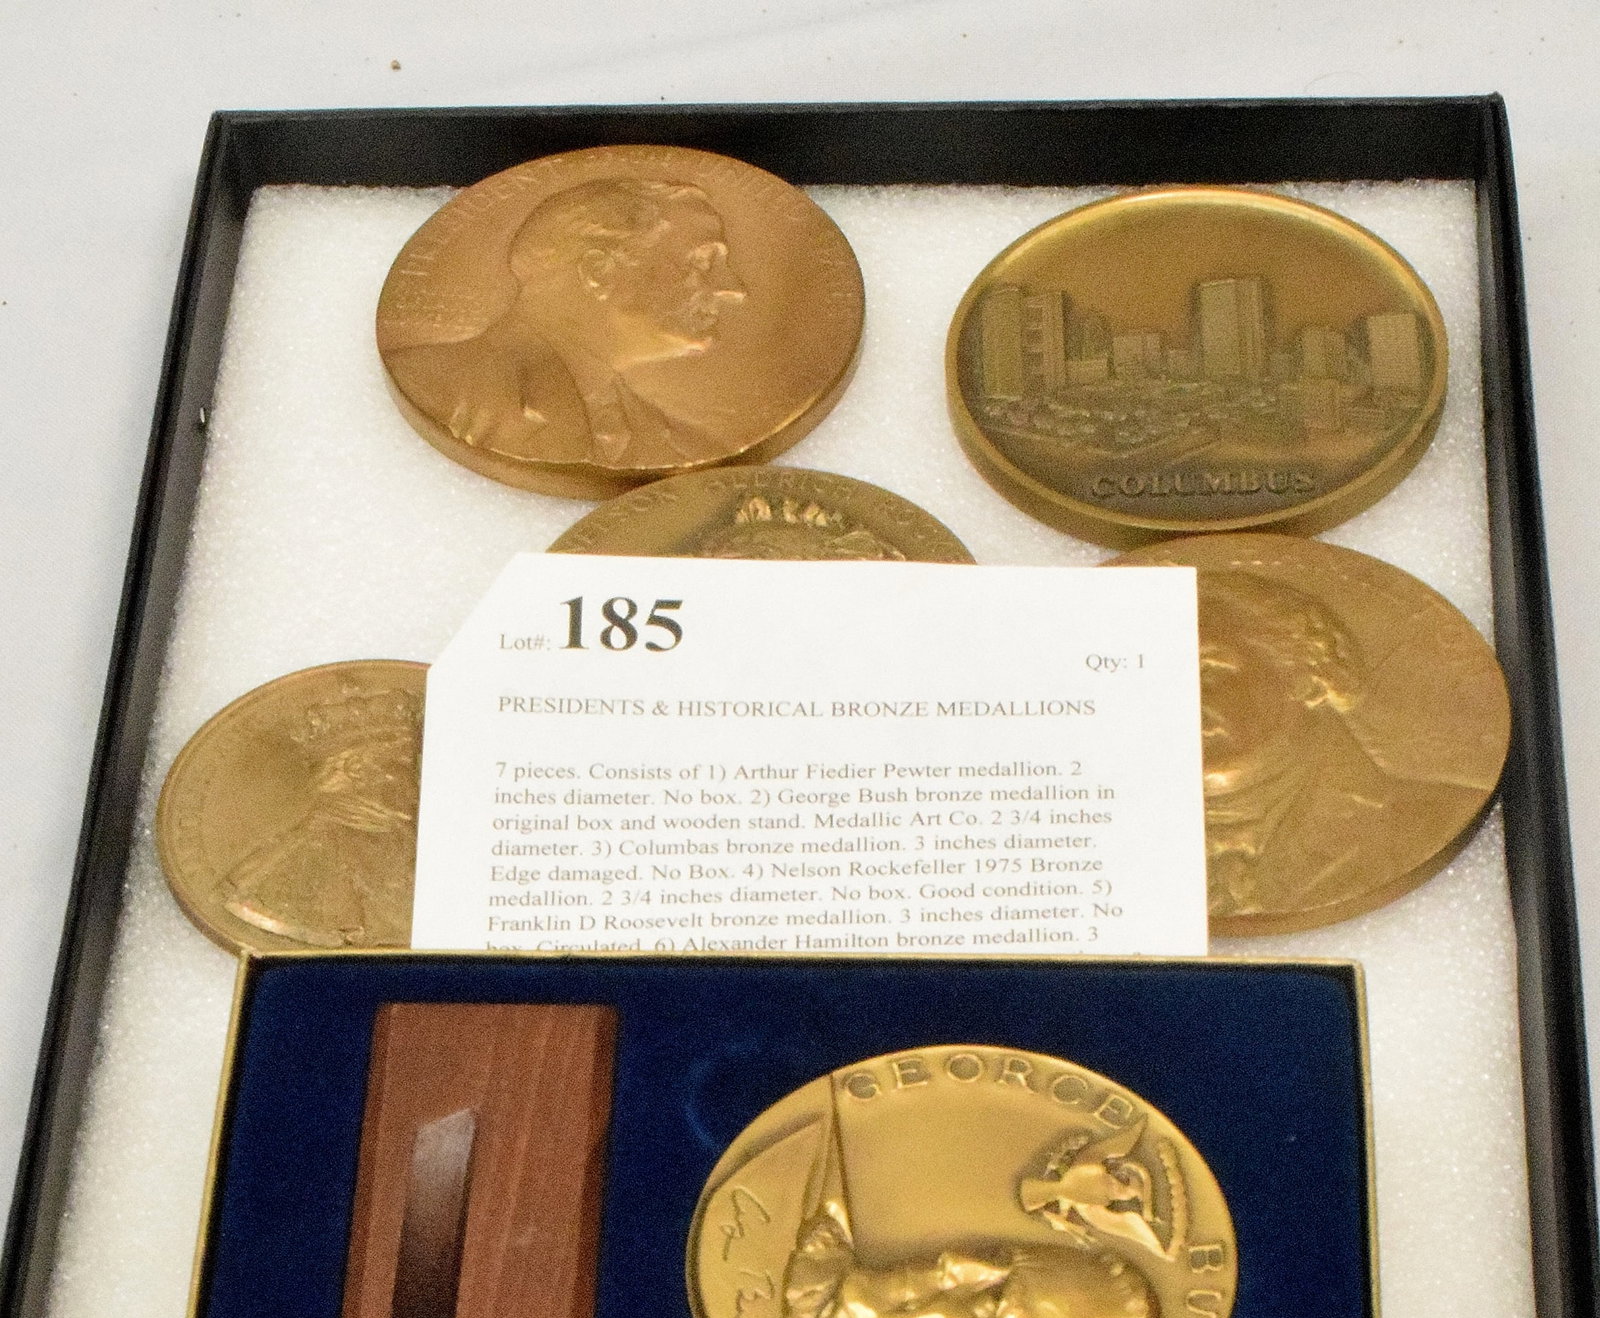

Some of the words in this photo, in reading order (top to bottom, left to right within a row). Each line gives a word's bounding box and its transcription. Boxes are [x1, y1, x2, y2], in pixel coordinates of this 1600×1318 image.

[1092, 469, 1315, 498] COLUMBUS
[499, 632, 552, 651] Lot#:
[559, 595, 685, 653] 185
[1085, 653, 1128, 672] Qty:
[1137, 653, 1146, 669] 1
[498, 695, 645, 718] PRESIDENTS
[651, 699, 670, 718] &
[678, 700, 824, 719] HISTORICAL
[831, 700, 929, 719] BRONZE
[936, 699, 1096, 718] MEDALLIONS
[495, 760, 507, 778] 7
[513, 761, 581, 784] pieces.
[588, 762, 673, 782] Consists
[678, 764, 702, 781] of
[709, 764, 727, 783] 1)
[733, 762, 799, 781] Arthur
[883, 762, 952, 780] Pewter
[958, 760, 1062, 779] medallion.
[1070, 760, 1082, 777] 2
[494, 786, 557, 806] inches
[562, 787, 656, 807] diameter.
[663, 788, 694, 806] No
[700, 788, 742, 806] box.
[750, 788, 772, 808] 2)
[776, 787, 851, 809] George
[858, 785, 909, 805] Bush
[915, 785, 983, 804] bronze
[990, 784, 1090, 802] medallion
[1097, 784, 1115, 801] in
[492, 813, 570, 836] original
[576, 813, 613, 832] box
[619, 813, 656, 832] and
[662, 812, 741, 831] wooden
[747, 812, 805, 831] stand.
[814, 810, 902, 830] Medallic
[909, 810, 942, 828] Art
[948, 810, 983, 827] Co.
[991, 808, 1003, 826] 2
[1010, 808, 1042, 826] 3/4
[1049, 807, 1113, 826] inches
[490, 838, 583, 858] diameter.
[591, 839, 613, 859] 3)
[618, 837, 720, 857] Columbas
[726, 837, 795, 855] bronze
[801, 835, 906, 855] medallion.
[914, 834, 925, 852] 3
[934, 833, 997, 852] inches
[1003, 832, 1097, 850] diameter.
[490, 864, 541, 886] Edge
[547, 864, 643, 886] damaged.
[651, 864, 682, 882] No
[689, 863, 735, 880] Box.
[742, 862, 764, 881] 4)
[770, 861, 842, 879] Nelson
[849, 857, 966, 878] Rockefeller
[975, 857, 1023, 875] 1975
[1030, 856, 1103, 874] Bronze
[488, 889, 593, 908] medallion.
[601, 889, 613, 907] 2
[621, 888, 652, 907] 3/4
[660, 887, 723, 905] inches
[729, 886, 822, 904] diameter.
[831, 884, 862, 902] No
[868, 884, 911, 902] box.
[918, 882, 976, 900] Good
[981, 880, 1083, 898] condition.
[1092, 878, 1113, 897] 5)
[488, 914, 571, 933] Franklin
[579, 914, 597, 932] D
[603, 912, 703, 932] Roosevelt
[710, 911, 779, 928] bronze
[786, 908, 892, 927] medallion.
[900, 906, 912, 925] 3
[920, 905, 984, 924] inches
[989, 904, 1084, 922] diameter.
[1092, 902, 1124, 918] No
[654, 937, 676, 951] 6)
[684, 933, 789, 951] Alexander
[795, 930, 889, 949] Hamilton
[896, 929, 967, 947] bronze
[972, 926, 1080, 945] medallion.
[1088, 925, 1099, 942] 3
[840, 1054, 1134, 1131] GEORGE
